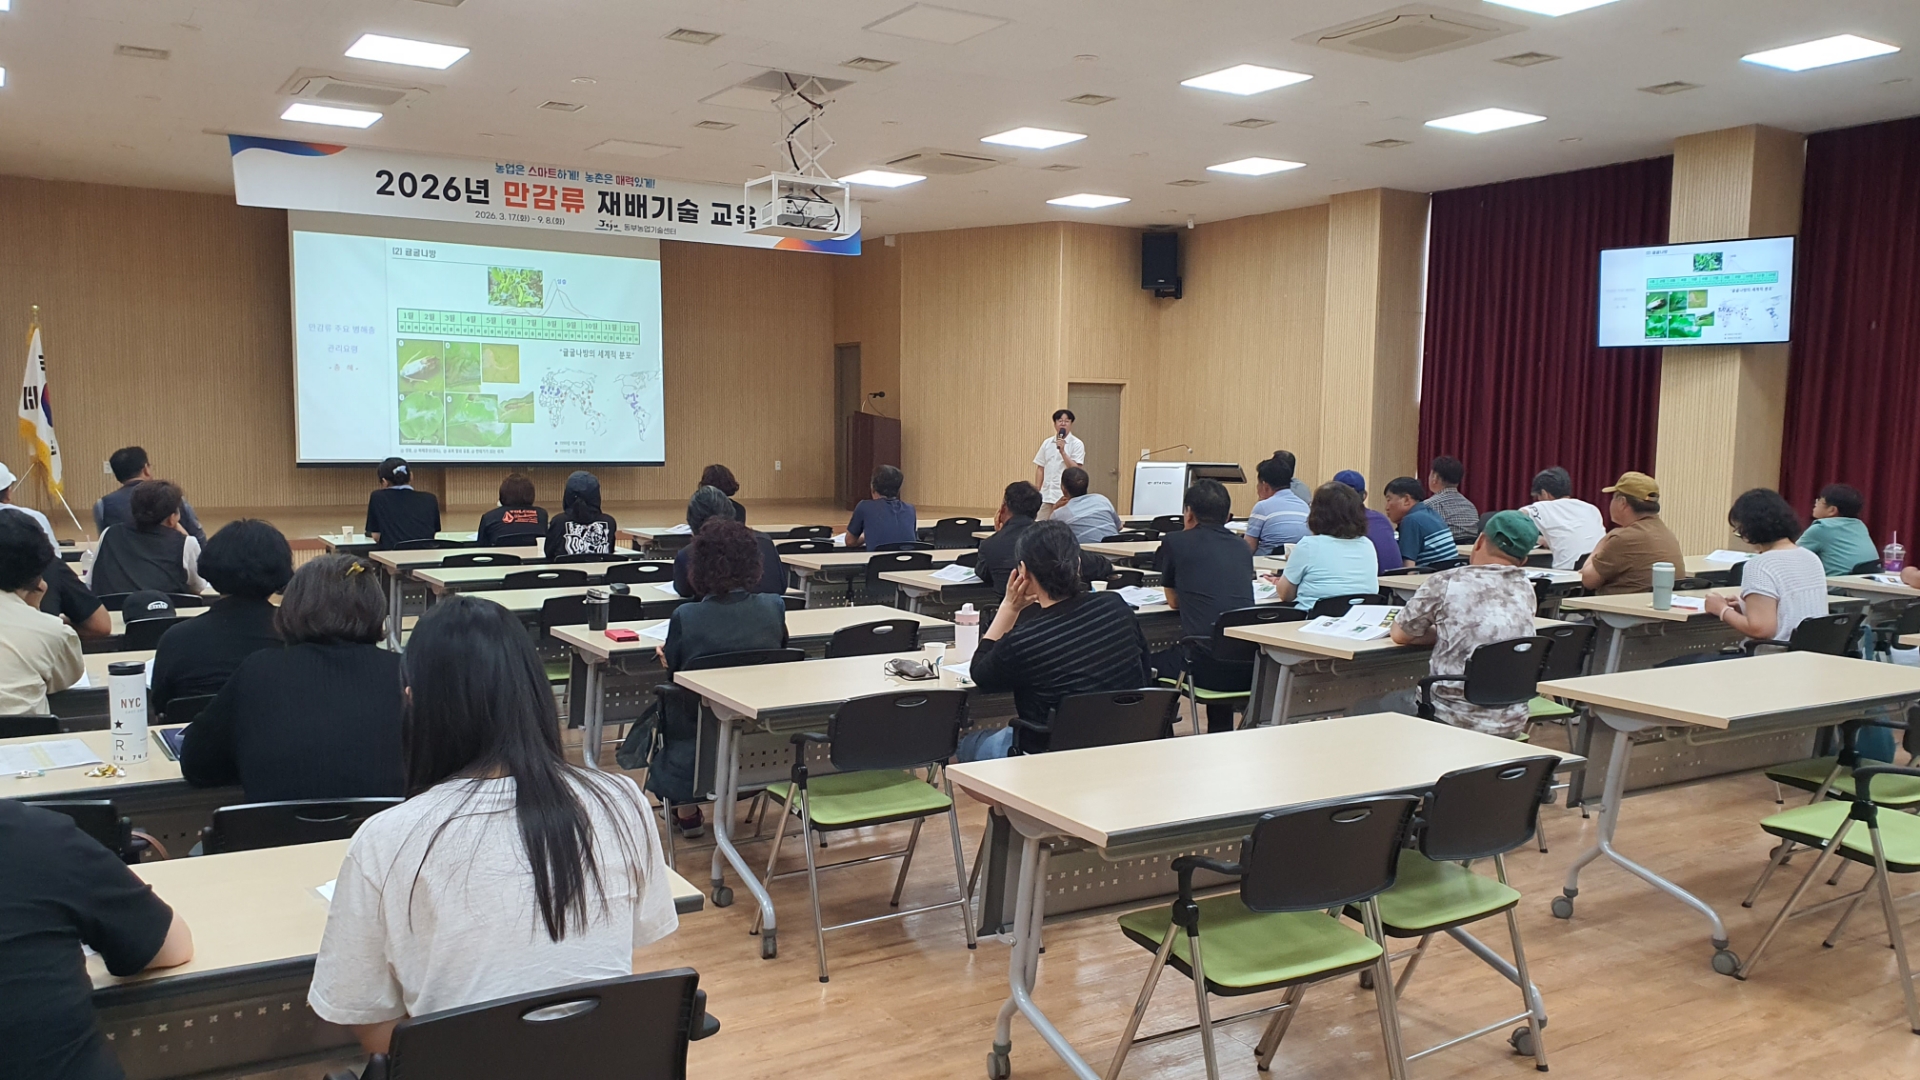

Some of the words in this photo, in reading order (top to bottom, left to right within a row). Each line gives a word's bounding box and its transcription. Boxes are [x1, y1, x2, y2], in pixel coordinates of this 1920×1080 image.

[495, 162, 525, 176] 농업은
[528, 166, 579, 181] 스마트하게!
[585, 171, 613, 185] 농촌은
[615, 175, 656, 189] 매력있게!
[375, 169, 490, 205] 2026년
[504, 181, 585, 214] 만감류
[597, 190, 699, 224] 재배기술
[710, 202, 757, 229] 교육
[475, 210, 497, 220] 2026.
[598, 219, 618, 231] Jeju
[624, 223, 677, 235] 동부농업기술센터
[392, 246, 402, 256] (2)
[120, 697, 141, 709] NYC
